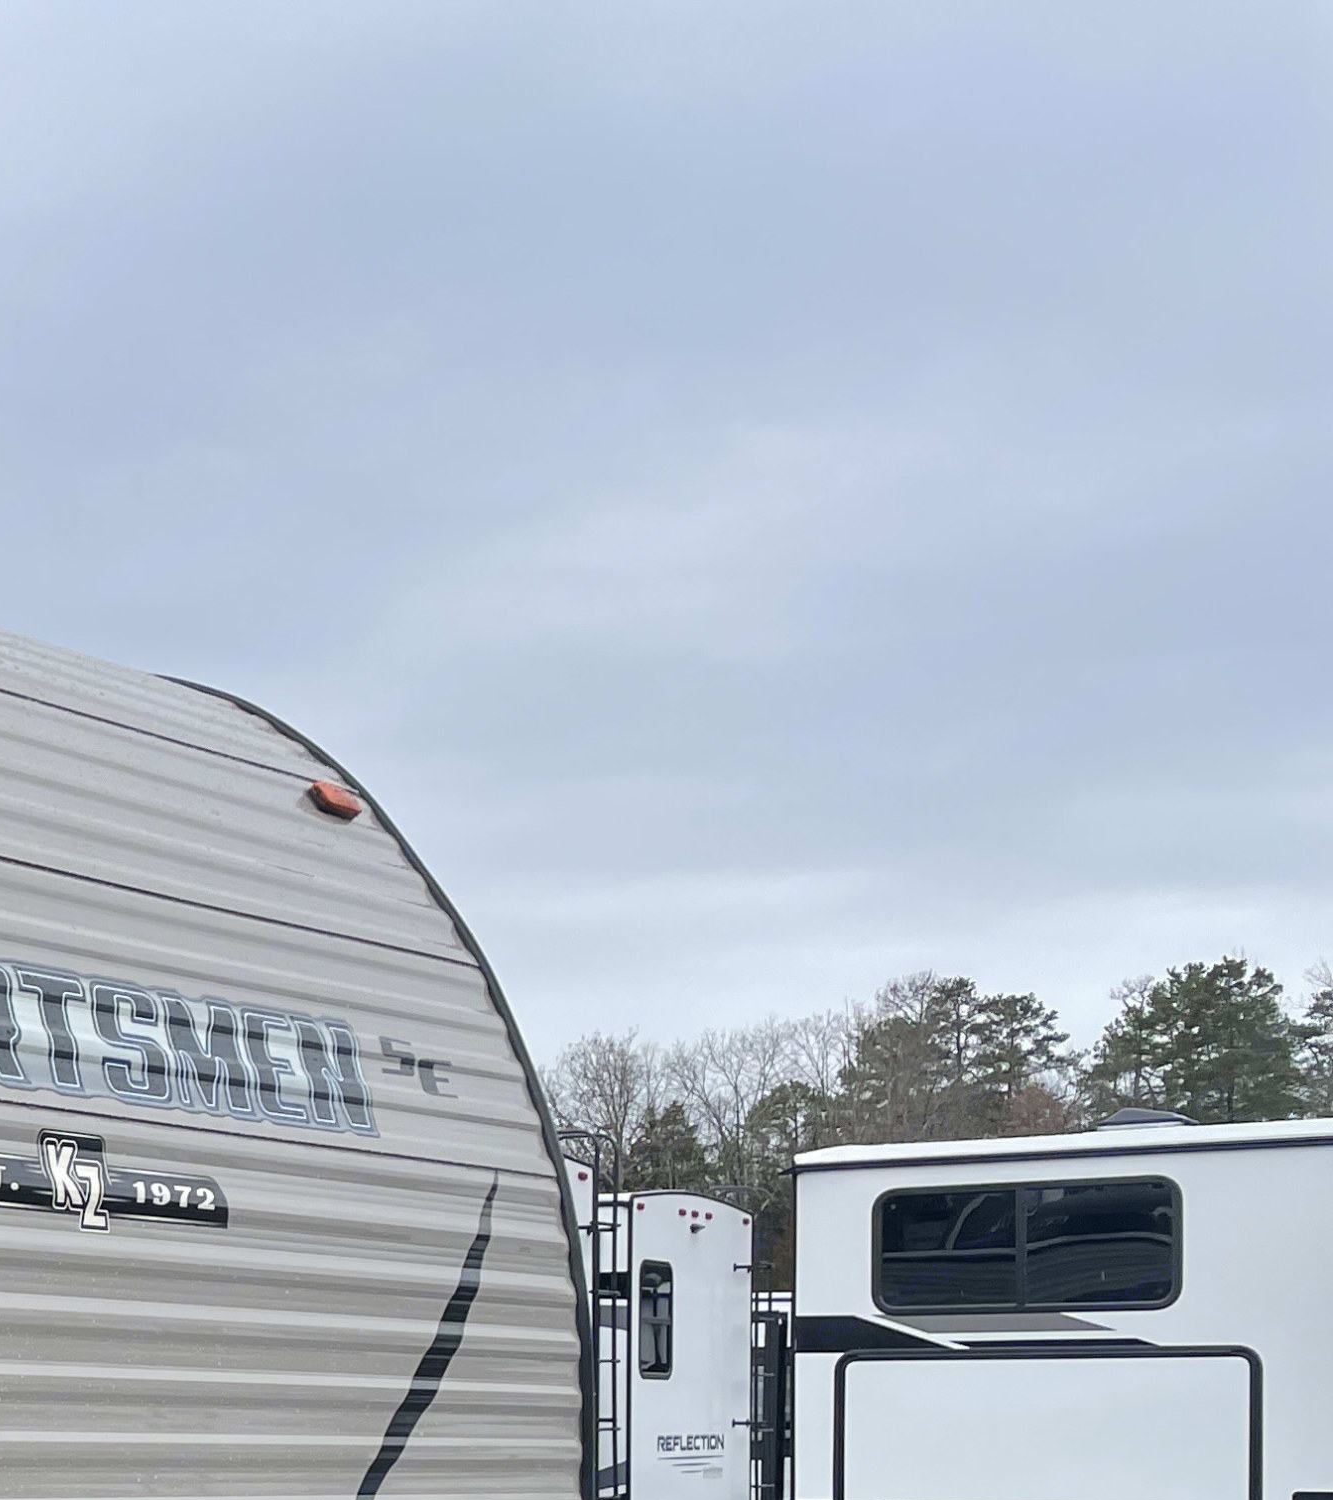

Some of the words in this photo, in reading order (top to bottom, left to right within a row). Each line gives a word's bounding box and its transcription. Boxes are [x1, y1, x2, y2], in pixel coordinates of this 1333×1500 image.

[379, 1035, 459, 1099] SE
[133, 1180, 216, 1211] 1972
[656, 1433, 725, 1452] REFLECTION
